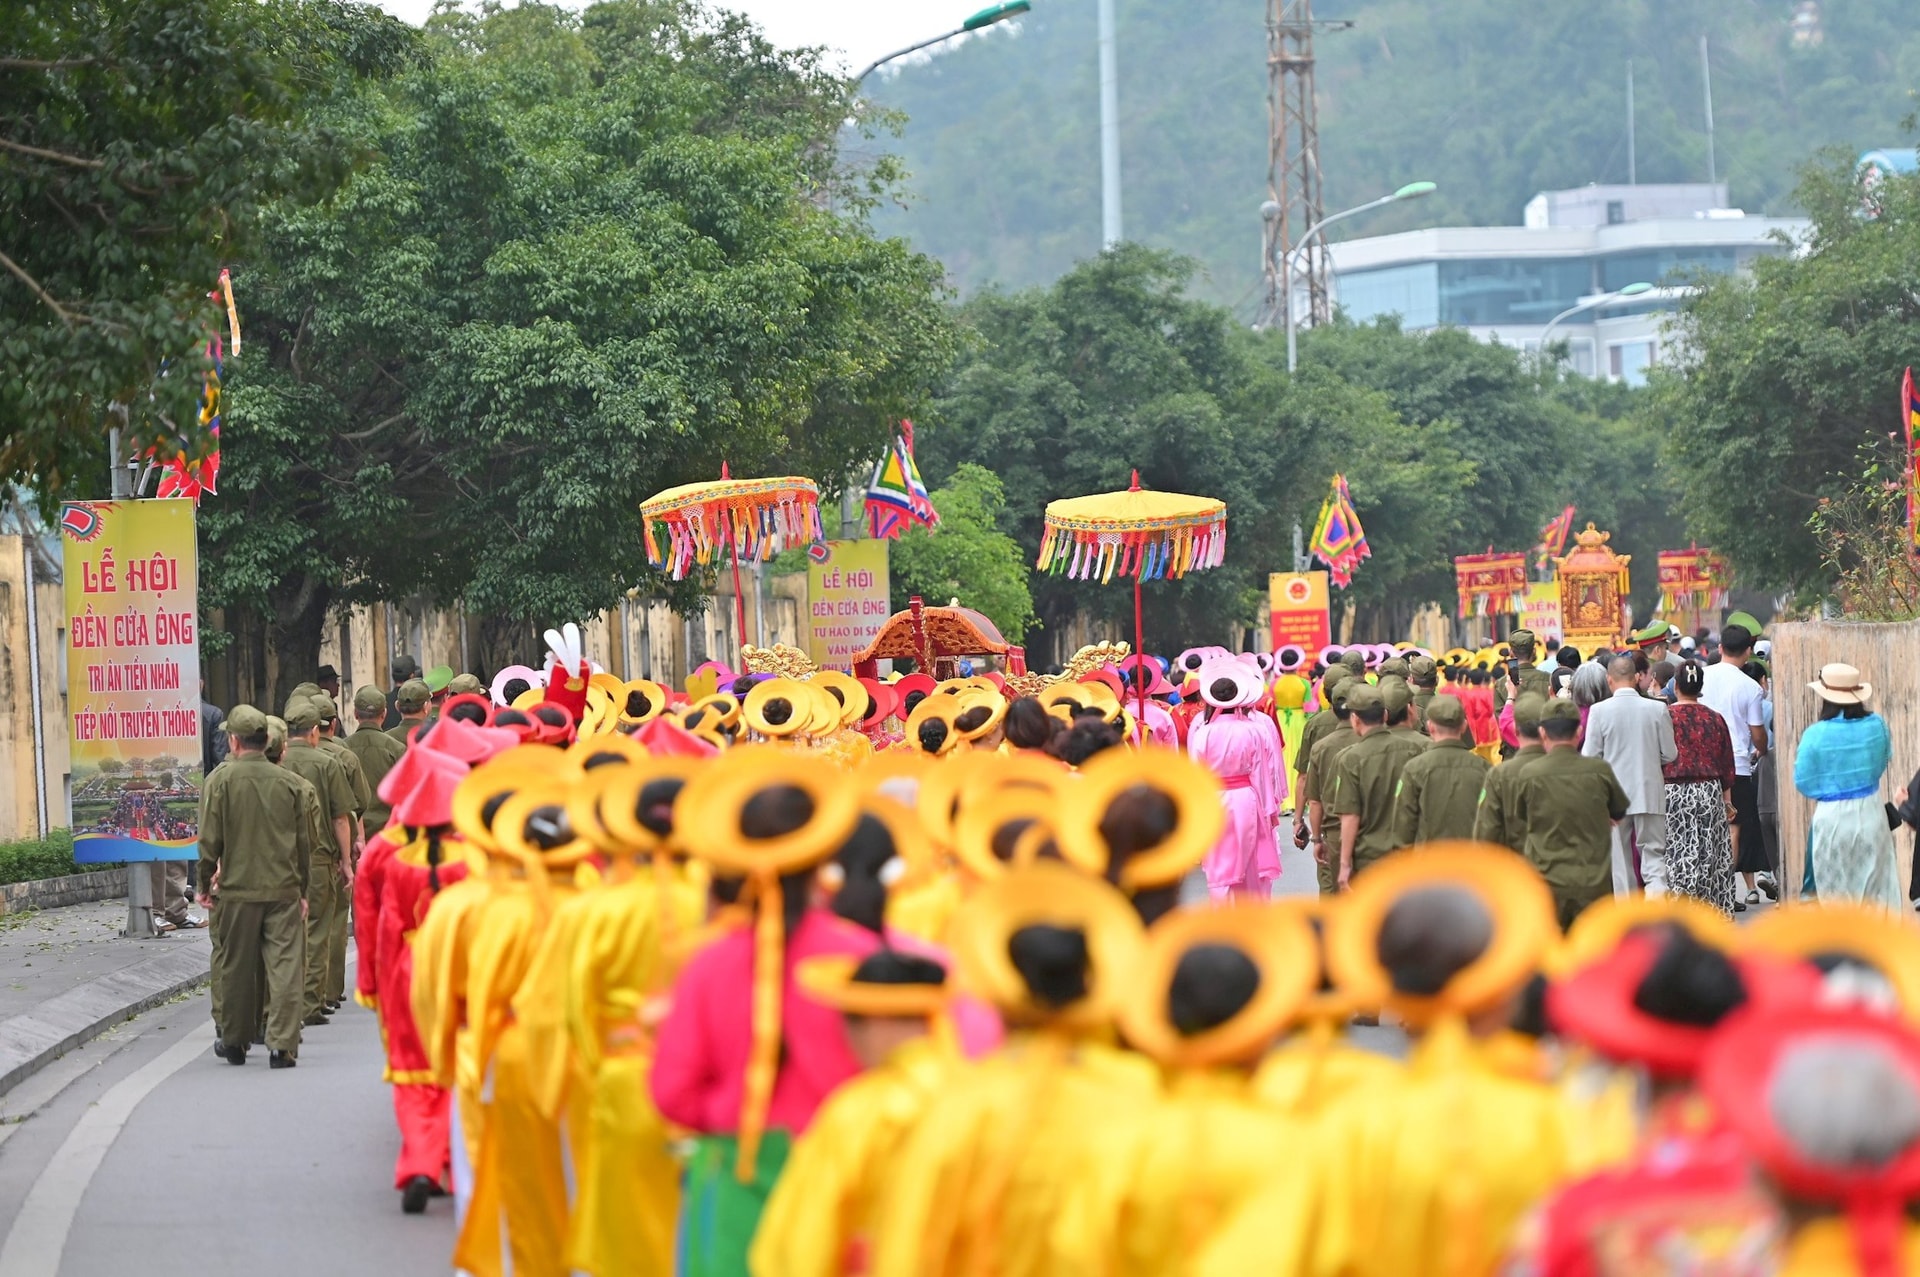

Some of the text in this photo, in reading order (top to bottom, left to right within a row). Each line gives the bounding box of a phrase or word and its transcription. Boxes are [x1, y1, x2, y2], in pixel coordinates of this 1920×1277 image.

[82, 547, 177, 599] LỄ HỘI
[846, 568, 873, 591] HỘI
[863, 597, 885, 615] ÔNG
[71, 603, 193, 648] ĐỀN CỬA ÔNG
[853, 626, 863, 636] DI
[88, 655, 179, 692] TRI ÂN TIỀN NHÂN
[74, 700, 197, 740] TIẾP NỐI TRUYỀN THỐNG
